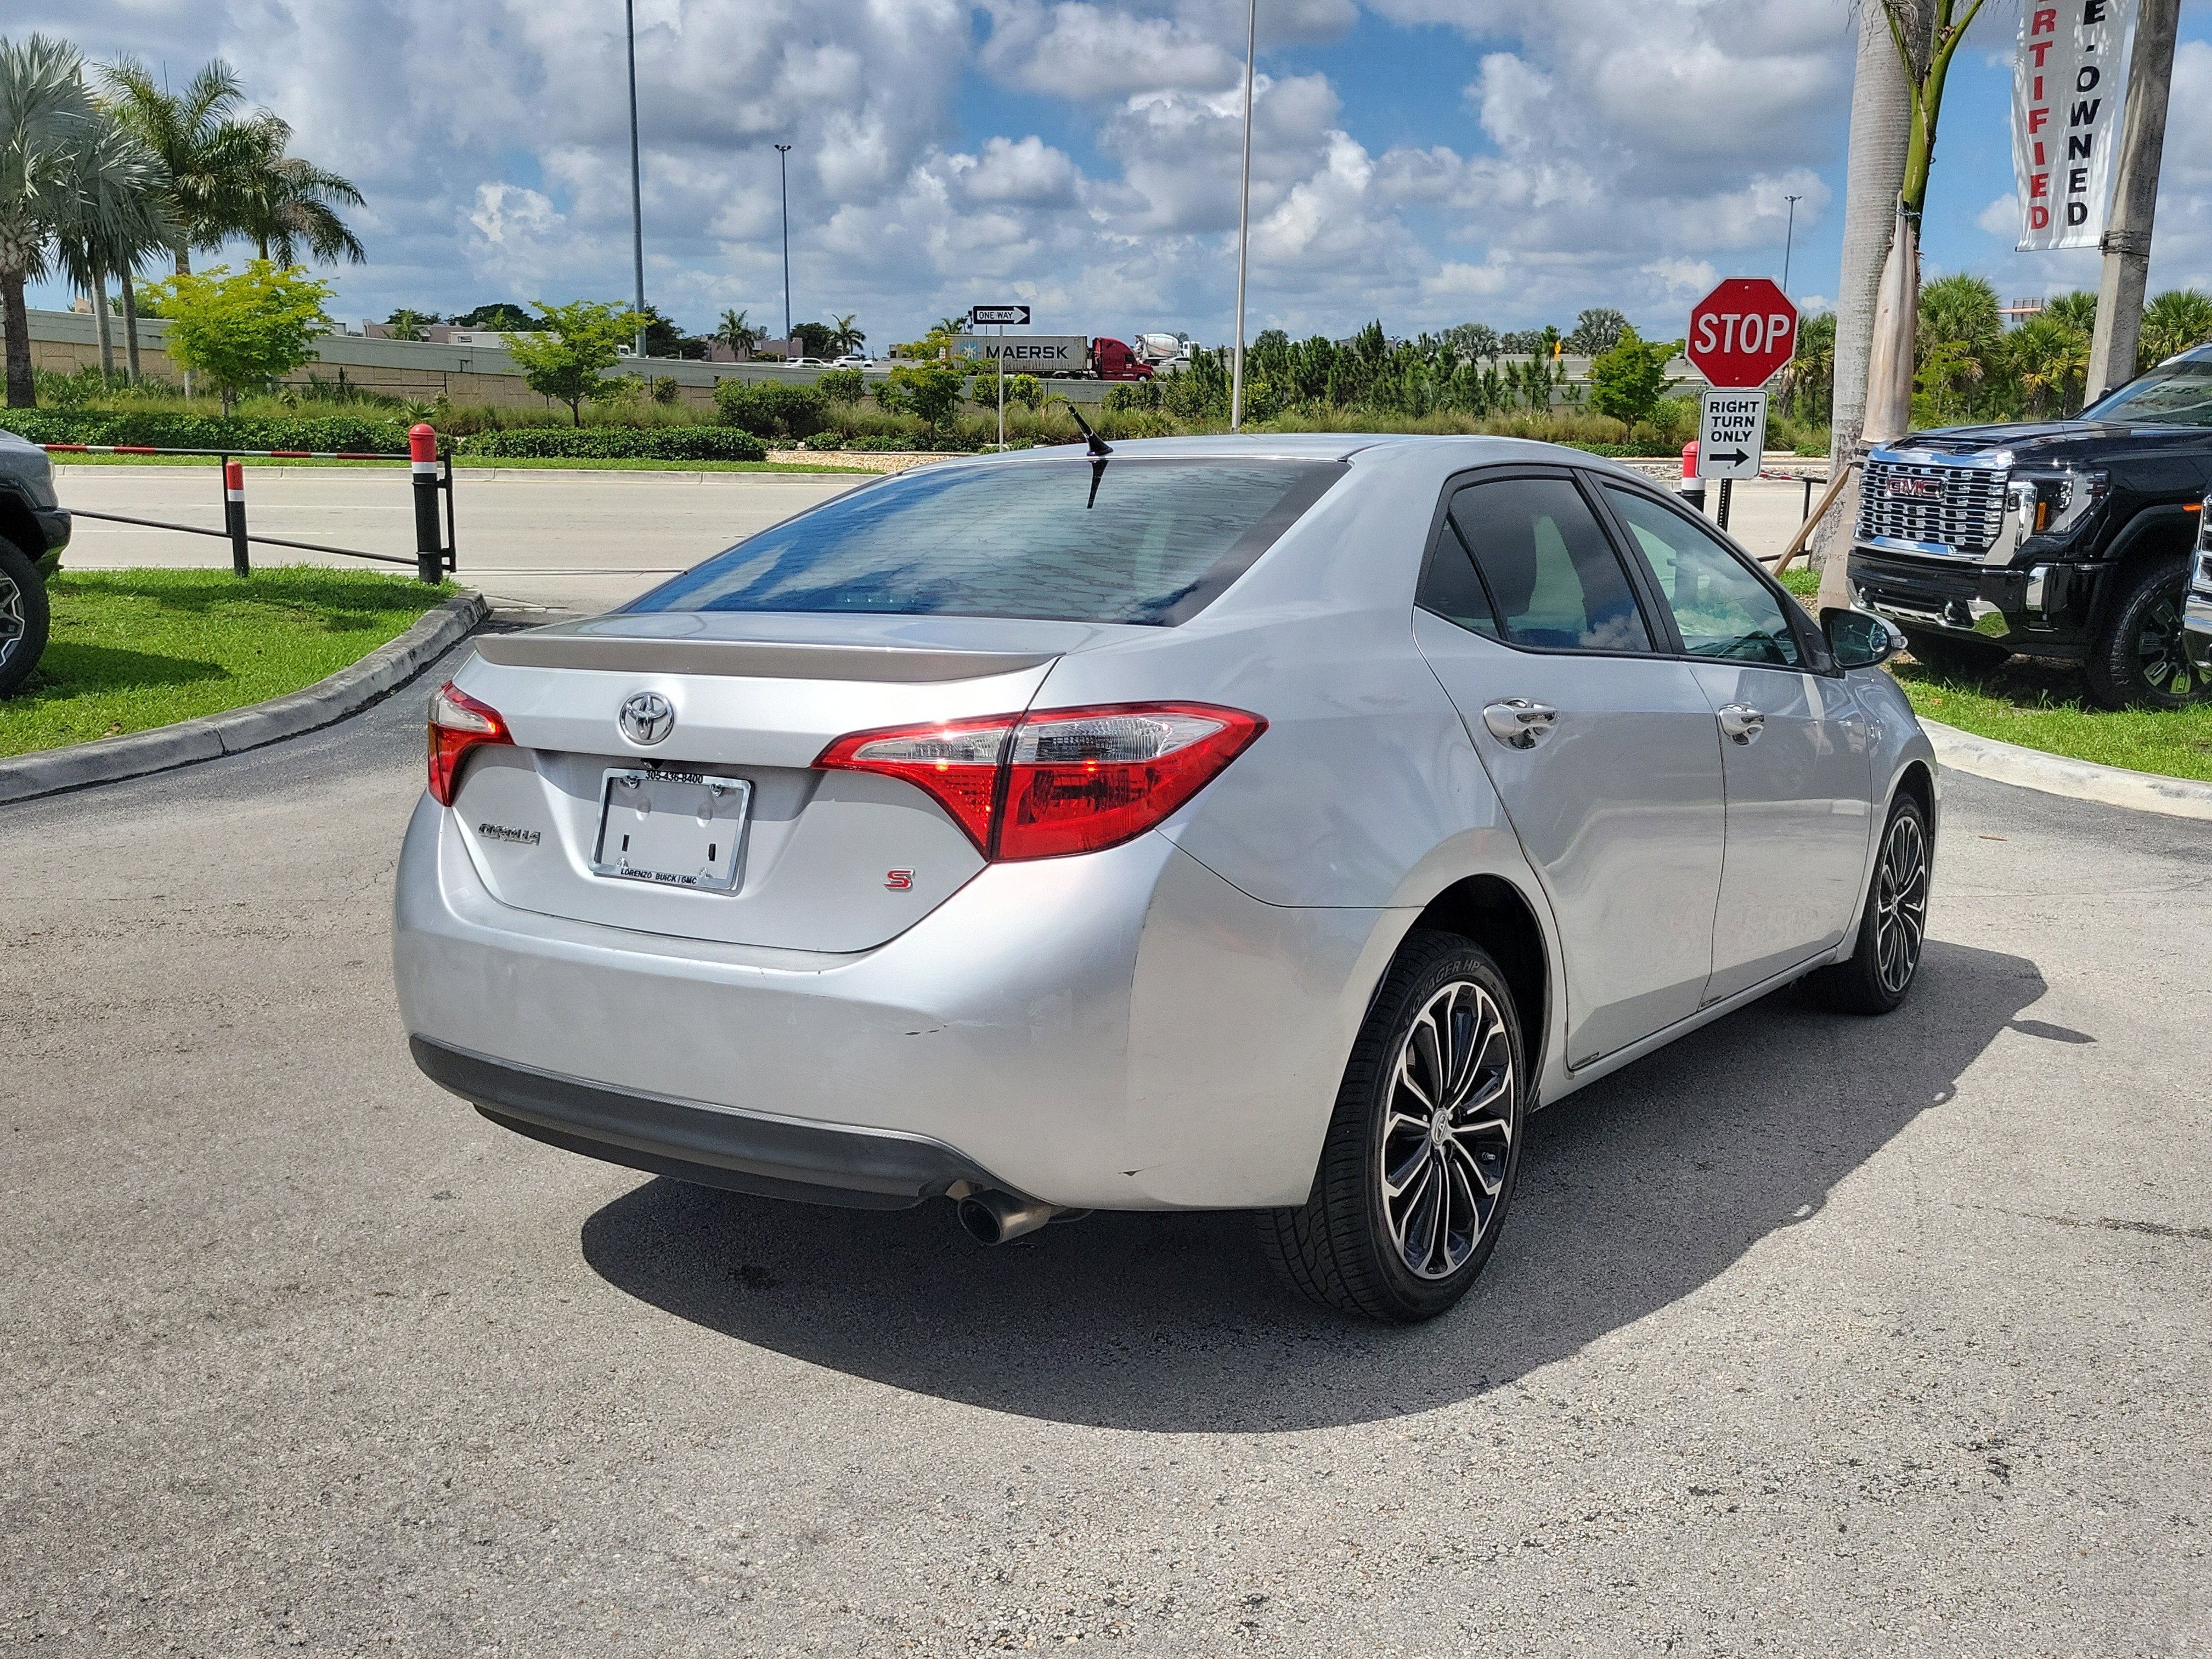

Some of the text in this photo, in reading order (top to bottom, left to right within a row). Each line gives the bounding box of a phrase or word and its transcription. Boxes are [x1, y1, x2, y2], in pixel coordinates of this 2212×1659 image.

[1695, 313, 1790, 353] STOP
[986, 346, 1069, 359] MAERSK
[1709, 401, 1760, 413] RIGHT
[1712, 416, 1755, 427] TURN
[1711, 431, 1752, 442] ONLY
[1888, 477, 1941, 498] GMC
[646, 769, 703, 784] 305-436-8400
[620, 868, 652, 878] LORENZO
[655, 873, 676, 882] BUICK
[681, 876, 697, 884] GMC
[883, 868, 915, 893] S
